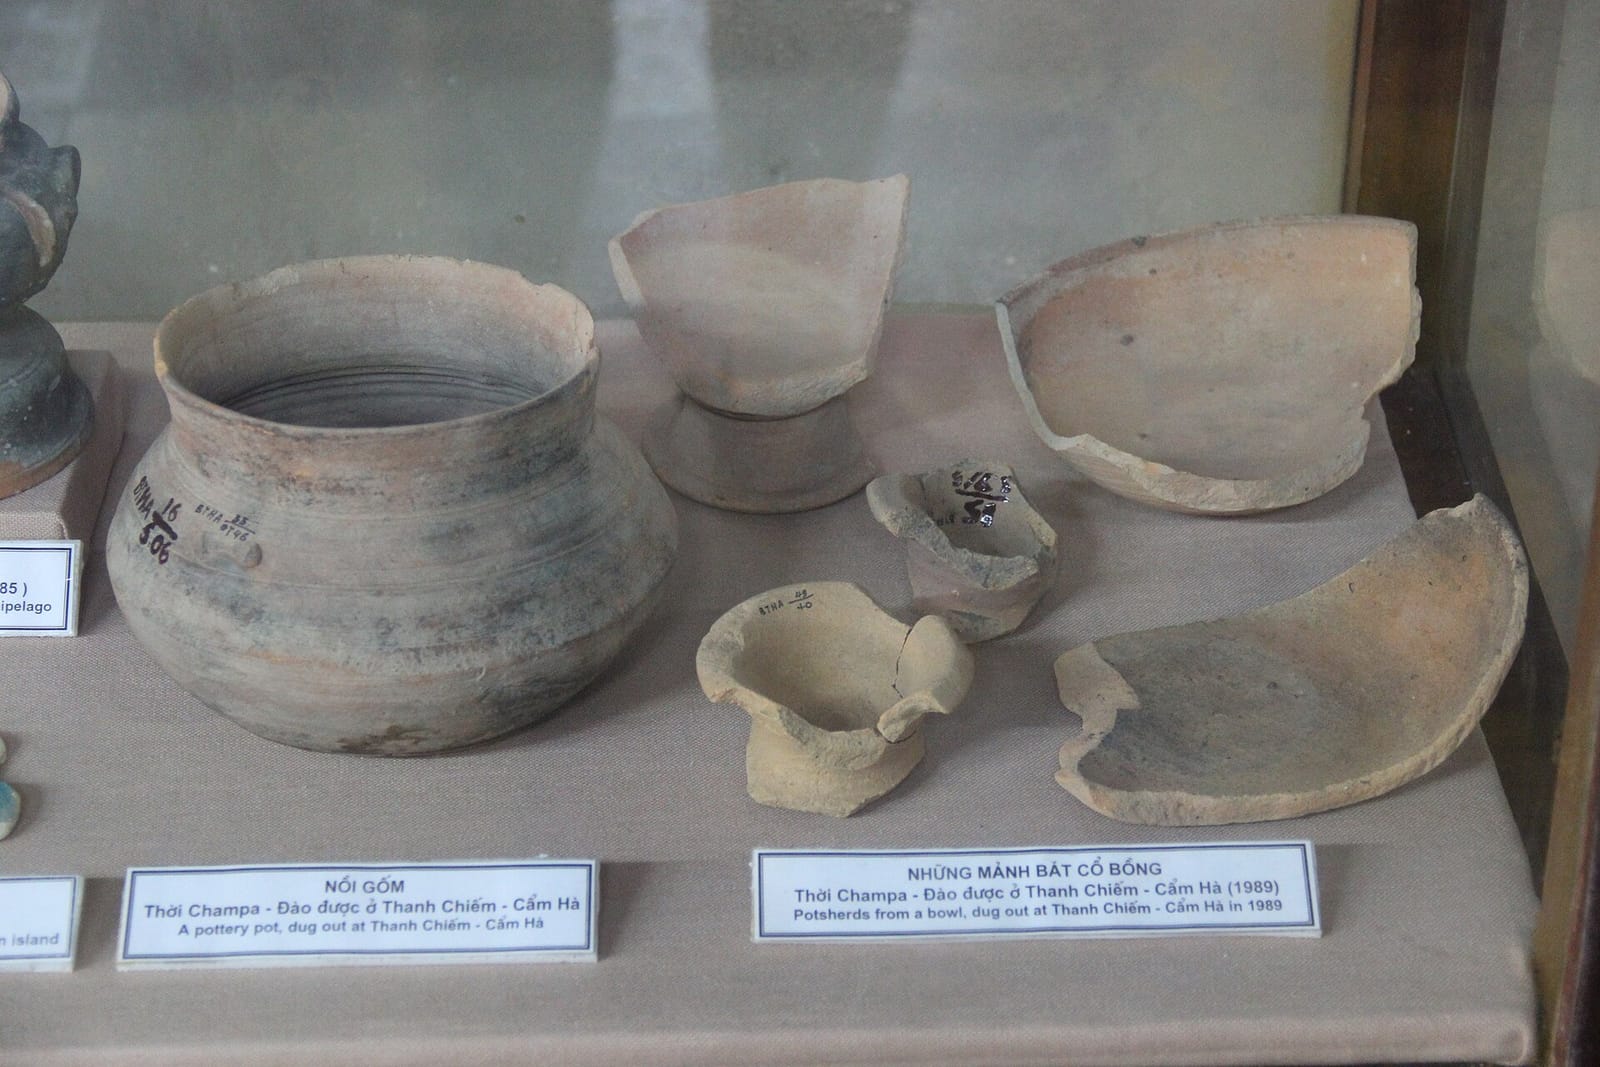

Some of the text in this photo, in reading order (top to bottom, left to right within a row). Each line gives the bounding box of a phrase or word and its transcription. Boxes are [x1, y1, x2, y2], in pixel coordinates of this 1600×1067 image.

[908, 863, 972, 881] NHỮNG
[978, 861, 1030, 879] MẢNH
[1036, 861, 1072, 877] BÁT
[363, 875, 404, 893] GỐM
[794, 889, 831, 903] Thời
[837, 888, 907, 905] Champa
[924, 887, 957, 901] Đào
[963, 886, 1004, 902] được
[1025, 884, 1078, 898] Thanh
[1199, 881, 1222, 895] Hà
[1228, 880, 1279, 897] (1989)
[144, 903, 182, 918] Thời
[188, 903, 260, 921] Champa
[277, 901, 311, 915] Đào
[317, 899, 360, 917] được
[383, 900, 436, 913] Thanh
[794, 908, 870, 921] Potsherds
[875, 908, 910, 920] from
[914, 910, 922, 919] a
[928, 907, 966, 919] bowl,
[972, 906, 1000, 921] dug
[1005, 906, 1029, 917] out
[1033, 904, 1047, 915] at
[1052, 903, 1098, 915] Thanh
[1229, 900, 1242, 912] in
[1250, 900, 1282, 912] 1989
[178, 924, 189, 936] A
[194, 922, 248, 938] pottery
[254, 922, 282, 937] pot,
[288, 921, 316, 936] dug
[322, 921, 346, 932] out
[351, 921, 365, 932] at
[370, 920, 417, 932] Thanh
